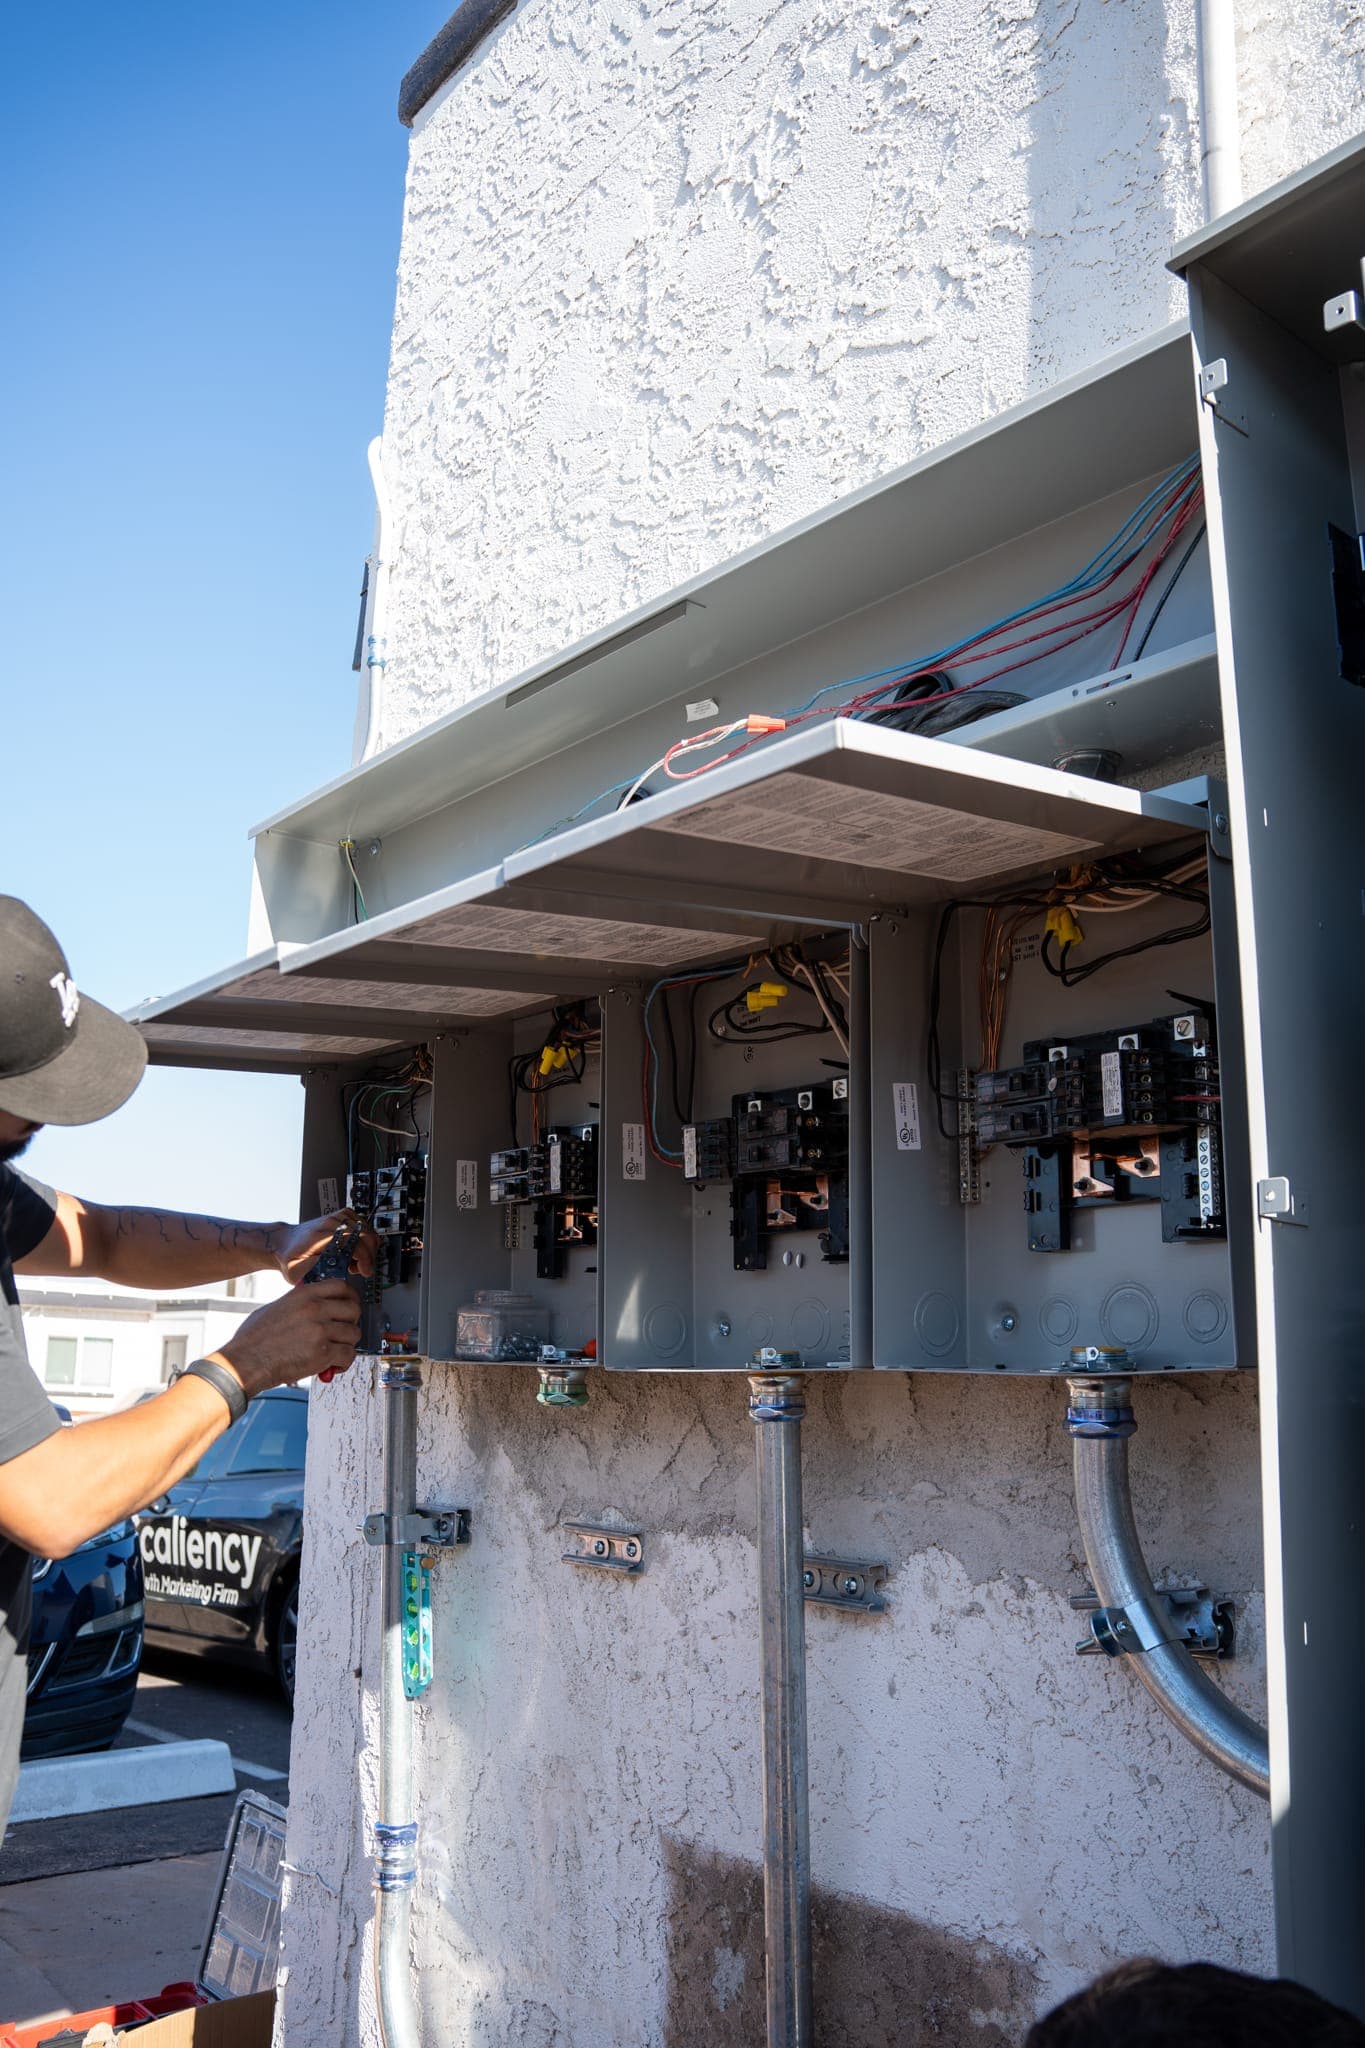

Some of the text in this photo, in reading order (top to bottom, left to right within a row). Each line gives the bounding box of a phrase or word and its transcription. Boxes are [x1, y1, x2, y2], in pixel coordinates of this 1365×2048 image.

[139, 1515, 262, 1589] caliency
[161, 1575, 212, 1605] Marketing
[212, 1583, 239, 1605] Firm
